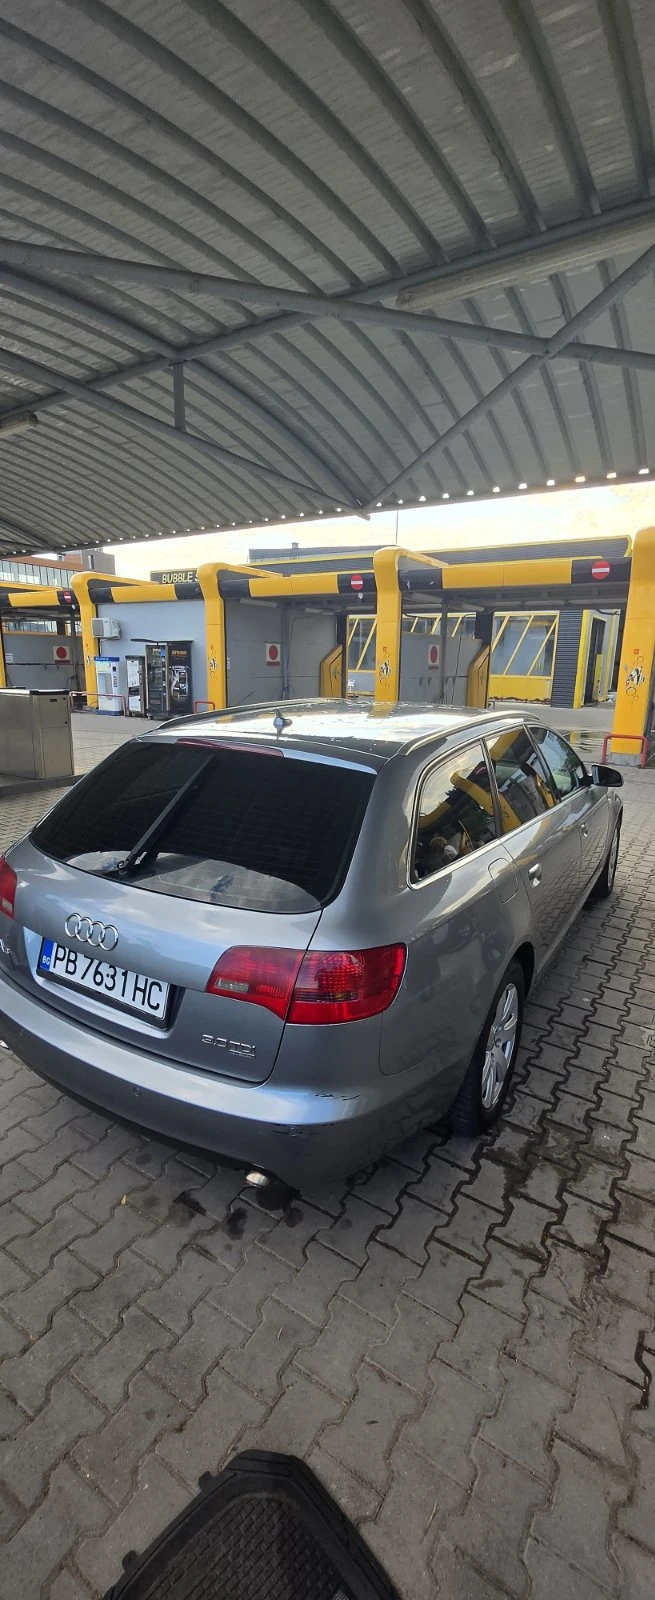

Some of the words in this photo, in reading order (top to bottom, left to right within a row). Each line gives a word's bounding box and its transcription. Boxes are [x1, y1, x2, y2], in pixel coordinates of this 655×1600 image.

[162, 571, 193, 584] BUBBLE
[42, 955, 51, 966] BG
[53, 944, 78, 975] PB
[81, 954, 129, 997] 7631
[132, 974, 163, 1011] HC
